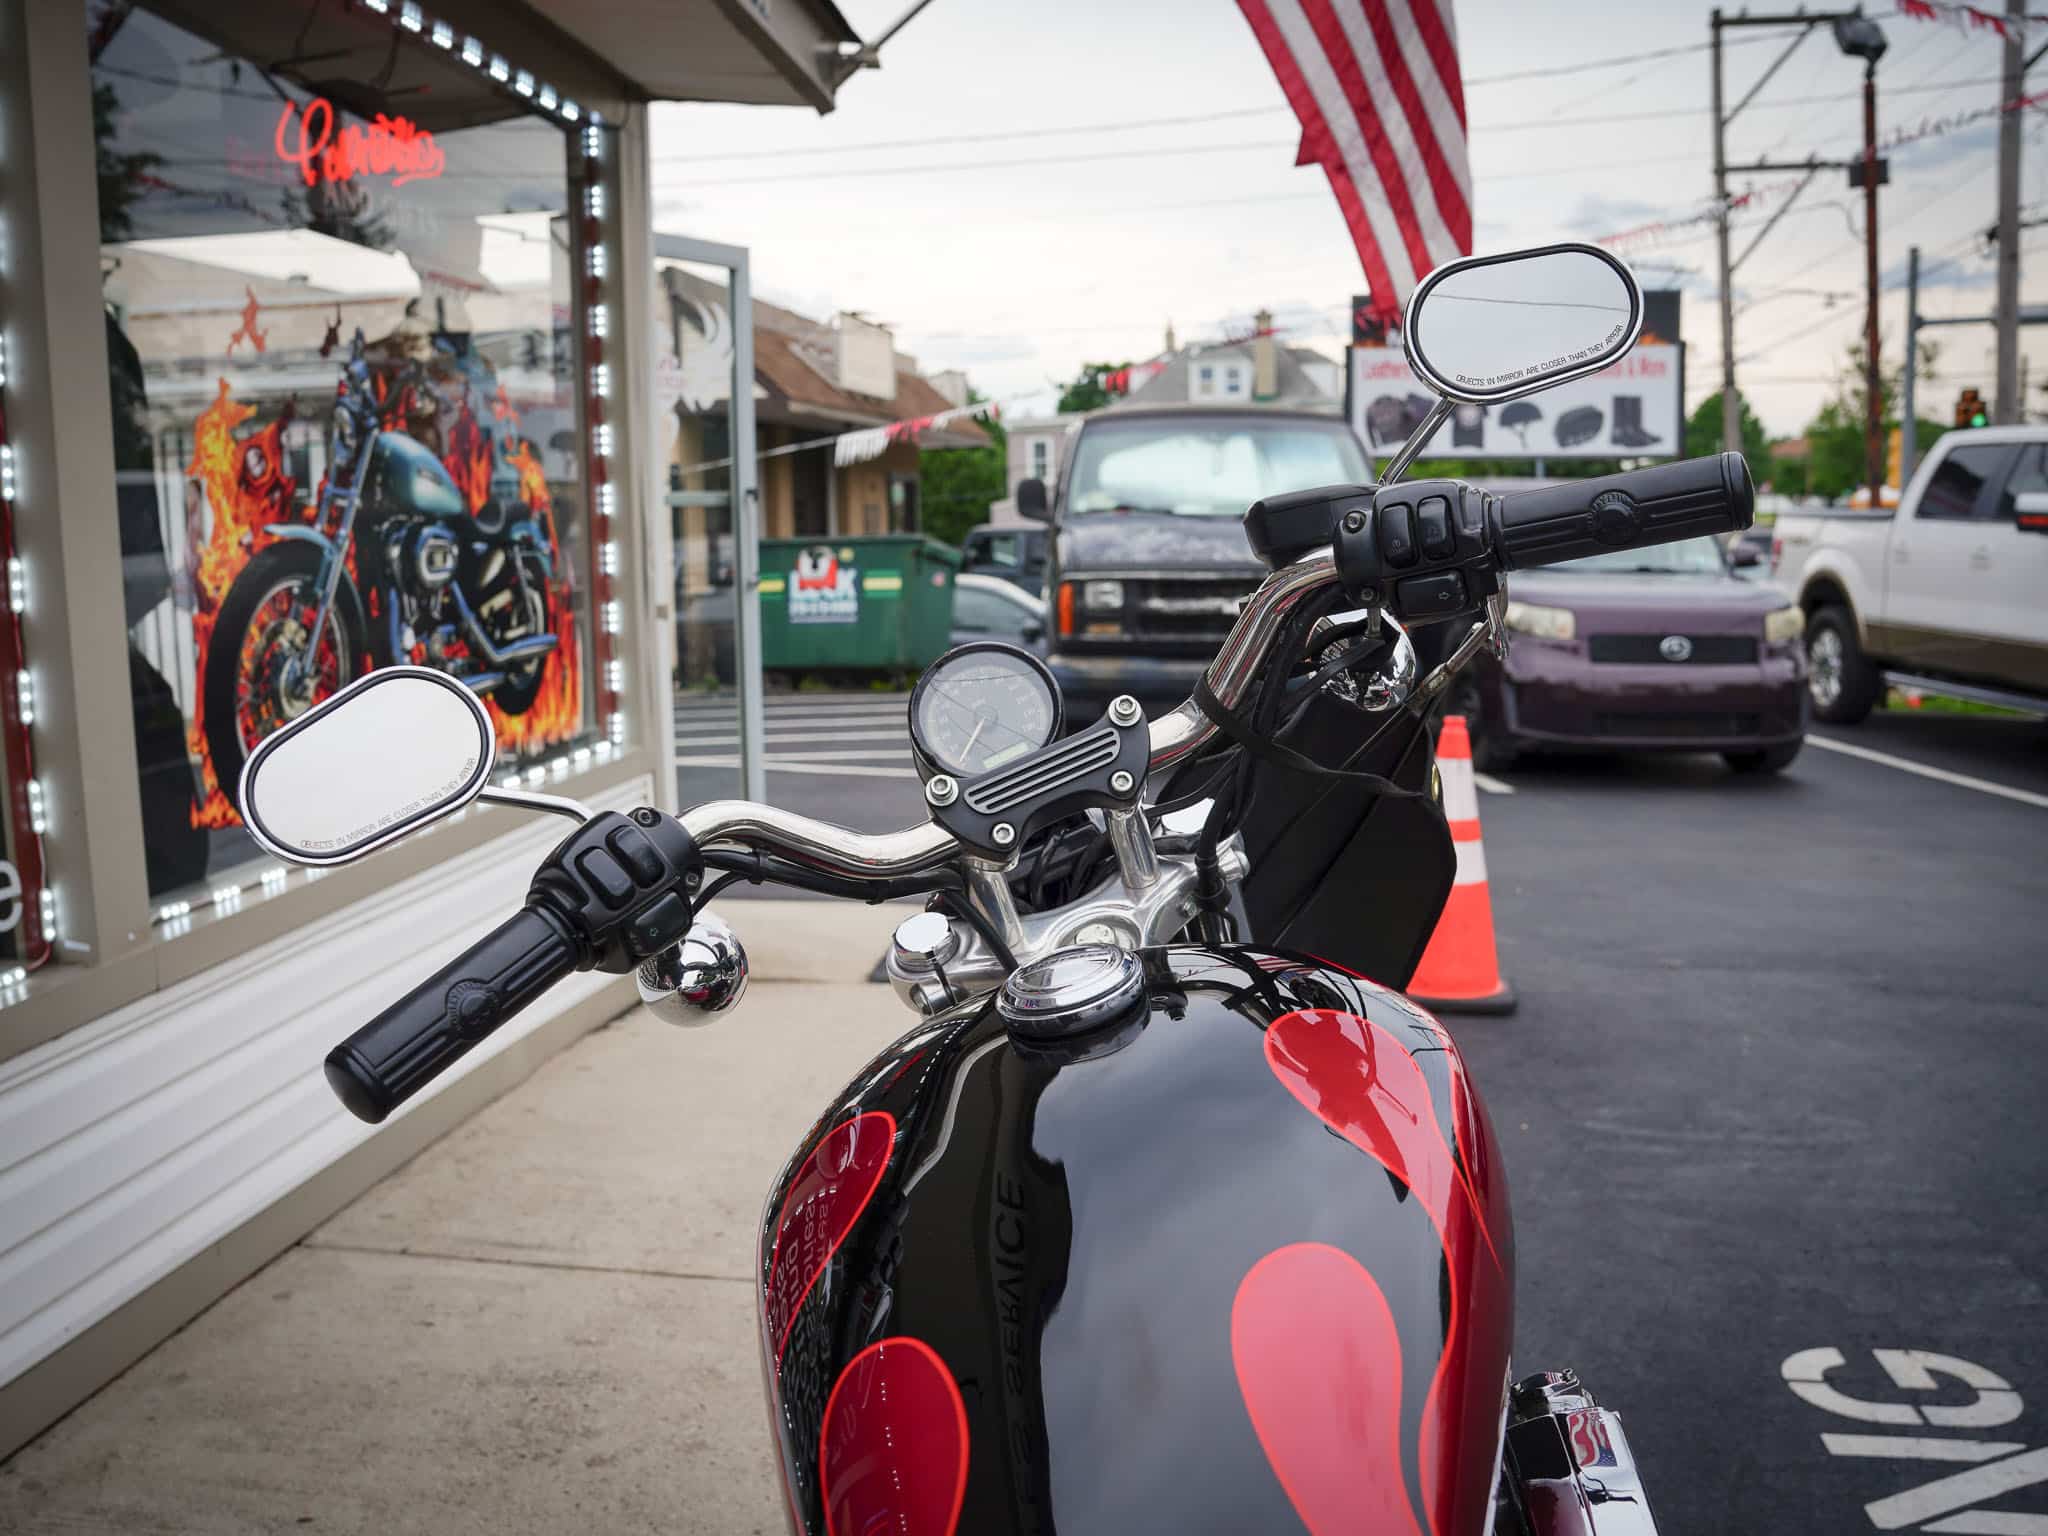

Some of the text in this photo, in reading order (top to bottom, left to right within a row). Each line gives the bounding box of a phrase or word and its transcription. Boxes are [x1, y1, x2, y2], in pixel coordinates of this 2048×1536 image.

[1456, 324, 1624, 387] OBJECTS IN MIRROR ARE CLOSER THAN THEY APPEAR
[301, 839, 335, 850] OBJECTS
[336, 836, 347, 847] IN
[346, 823, 377, 843] MIRROR
[377, 814, 393, 829] ARE
[392, 801, 422, 821] CLOSER
[421, 791, 443, 807] THAN
[441, 780, 461, 795] THEY
